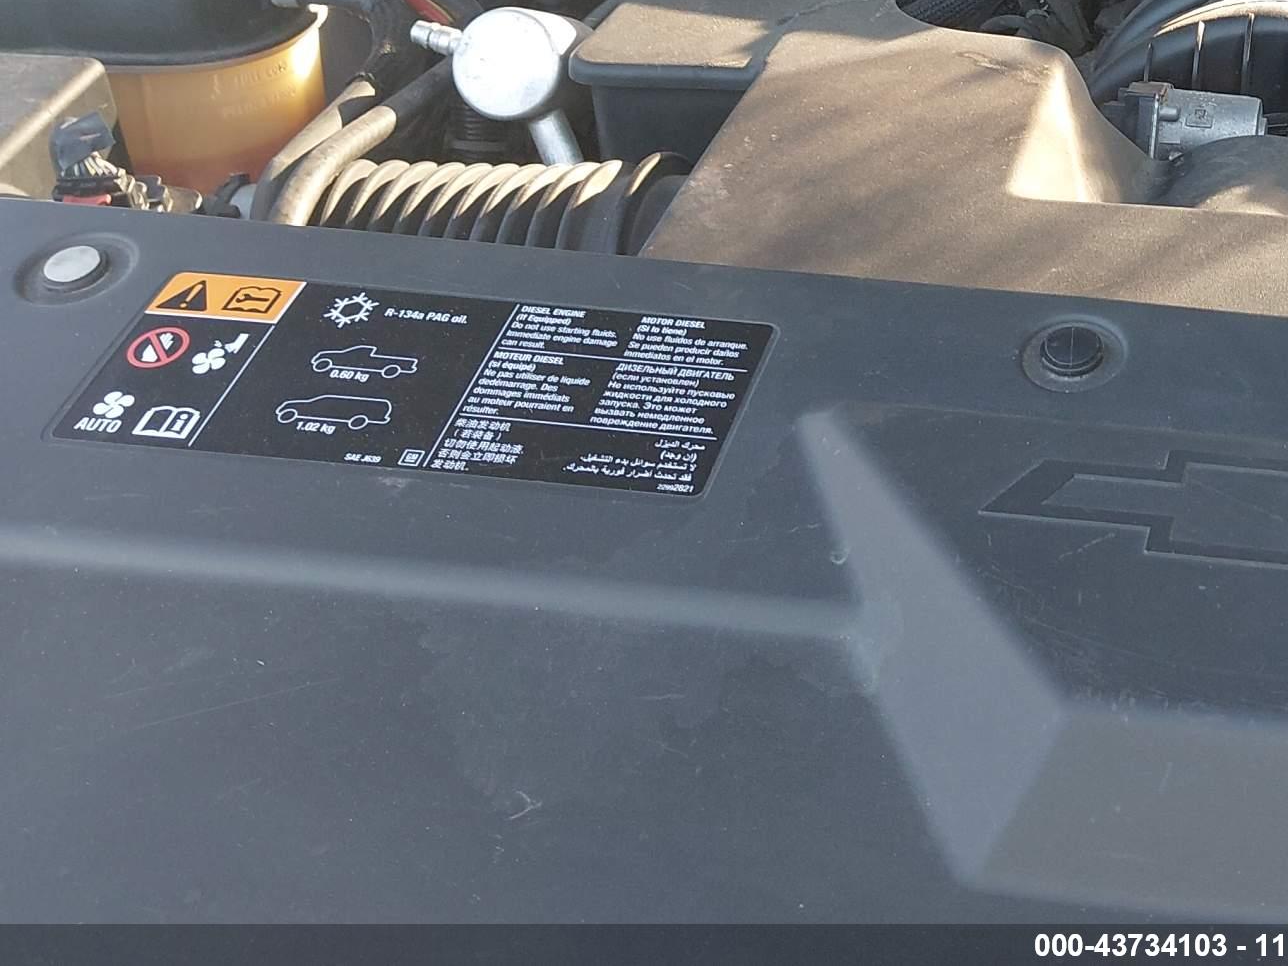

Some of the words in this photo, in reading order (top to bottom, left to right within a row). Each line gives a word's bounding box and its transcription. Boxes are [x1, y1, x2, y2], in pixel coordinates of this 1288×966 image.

[384, 308, 424, 321] R-134a
[426, 311, 450, 322] PAG
[451, 313, 467, 324] oil.
[521, 306, 551, 315] DIESEL
[553, 308, 586, 318] ENGINE
[528, 315, 571, 325] Equipped)
[641, 317, 674, 326] MOTOR
[675, 319, 706, 329] DIESEL
[558, 326, 590, 336] starting
[591, 329, 617, 338] fluids.
[637, 324, 650, 333] (Si
[662, 327, 687, 336] tiene)
[506, 330, 552, 340] Immediate
[553, 336, 582, 344] engine
[583, 338, 618, 348] damage
[519, 340, 545, 349] result.
[632, 333, 645, 341] No
[664, 336, 693, 345] fluidos
[694, 338, 706, 346] de
[708, 340, 748, 350] arranque.
[628, 341, 640, 349] Se
[641, 344, 674, 352] pueden
[675, 346, 712, 356] producir
[713, 348, 739, 358] daños
[494, 351, 532, 362] MOTEUR
[533, 355, 564, 365] DIESEL
[624, 350, 671, 361] inmediatos
[686, 354, 694, 362] el
[696, 356, 724, 365] motor.
[488, 360, 501, 368] (si
[502, 361, 536, 372] équipé)
[616, 362, 677, 376] ДИЗЕЛЬНЫЙ
[678, 369, 735, 381] ДВИГАТЕЛЬ
[329, 369, 353, 380] 0.60
[353, 371, 370, 383] kg
[497, 371, 514, 379] pas
[515, 372, 546, 382] utiliser
[547, 374, 559, 382] de
[560, 376, 590, 386] liquide
[612, 372, 639, 382] (если
[640, 376, 700, 388] установлен)
[473, 387, 522, 398] dommages
[523, 392, 570, 403] immédiats
[541, 384, 558, 392] Des
[608, 381, 621, 389] Не
[622, 383, 685, 396] используйте
[467, 396, 480, 404] au
[481, 398, 513, 406] moteur
[514, 400, 561, 411] pourraient
[603, 391, 652, 401] жидкости
[674, 397, 727, 408] холодного
[463, 404, 499, 415] résulter.
[594, 408, 635, 418] вызвать
[599, 400, 640, 409] запуска.
[643, 402, 662, 410] Это
[664, 405, 698, 414] может
[73, 417, 122, 433] AUTO
[295, 421, 319, 433] 1.02
[319, 423, 337, 434] kg
[454, 418, 511, 432] 柴油发动机
[590, 416, 658, 429] повреждение
[659, 423, 714, 435] двигателя.
[344, 453, 361, 462] SAE
[437, 448, 518, 465] 否则会立即损坏
